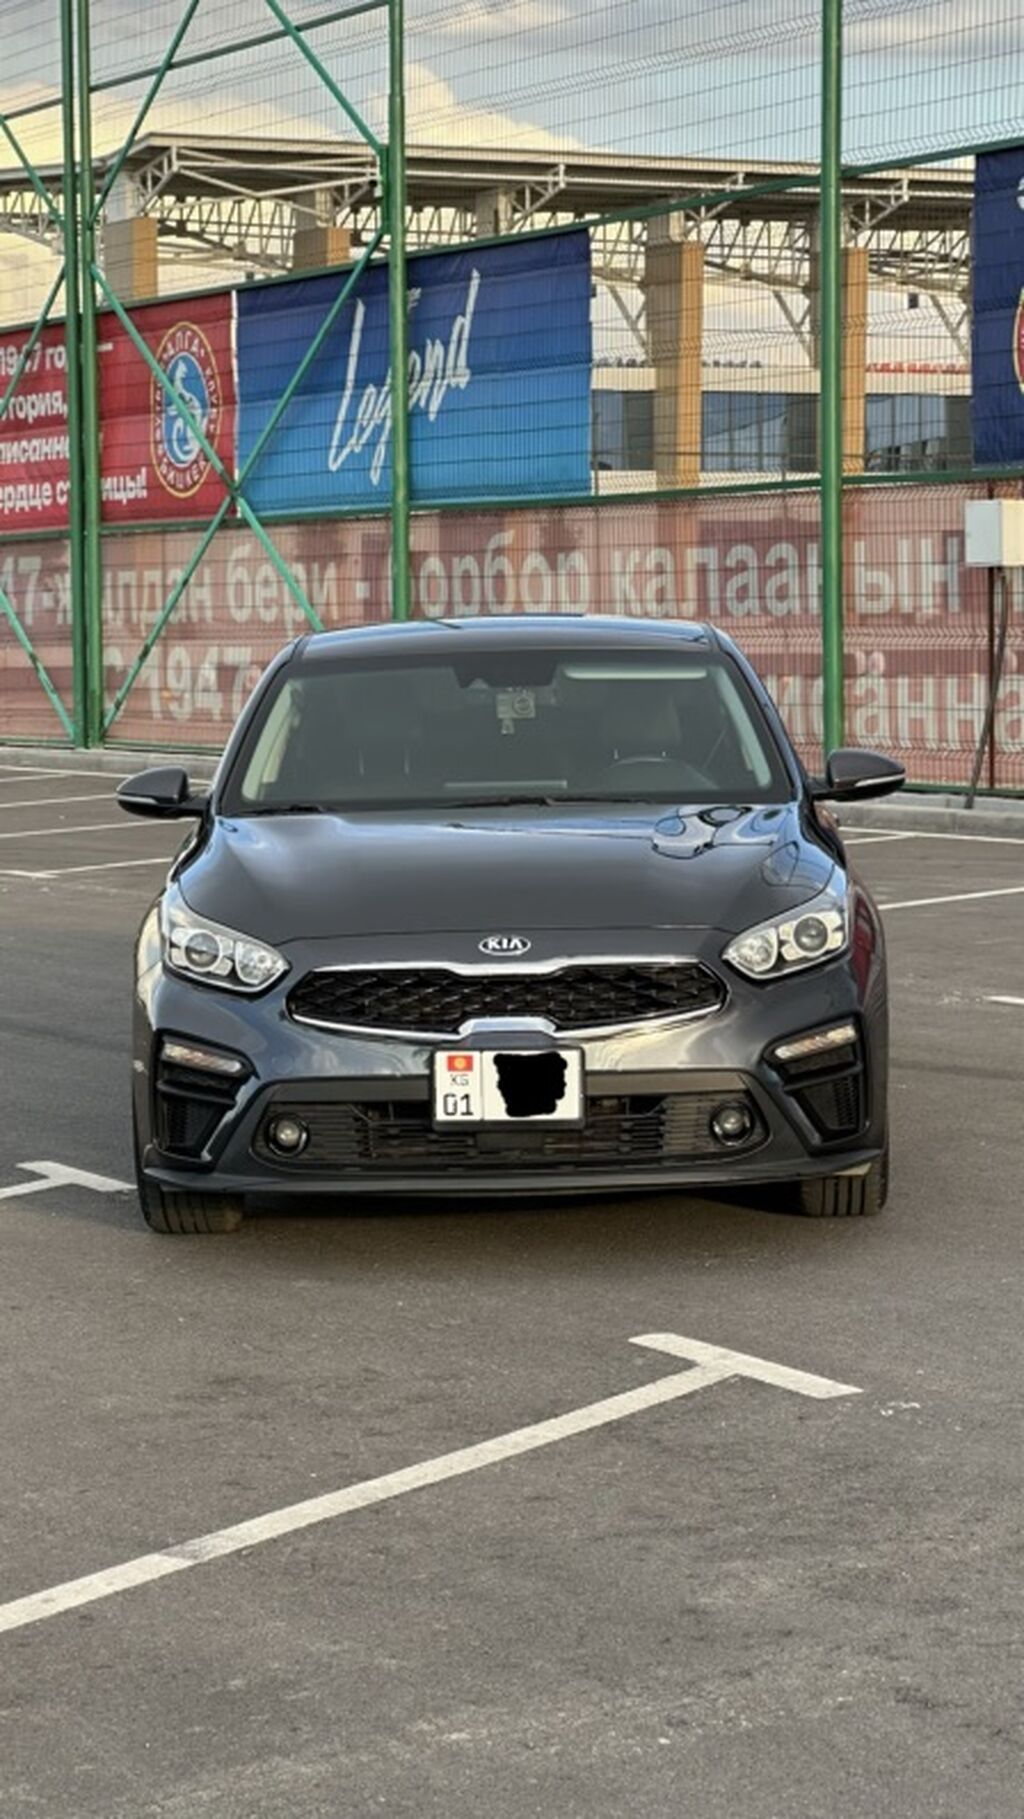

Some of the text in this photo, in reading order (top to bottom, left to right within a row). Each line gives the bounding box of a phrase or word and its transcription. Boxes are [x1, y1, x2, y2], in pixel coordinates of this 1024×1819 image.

[0, 342, 42, 376] 197
[46, 343, 68, 372] го
[1, 389, 68, 423] тория,
[0, 466, 147, 514] рдце сицы!
[226, 543, 338, 639] бери
[388, 530, 588, 618] орбор
[486, 936, 523, 950] KIA
[450, 1073, 469, 1087] KG
[443, 1093, 474, 1117] 01
